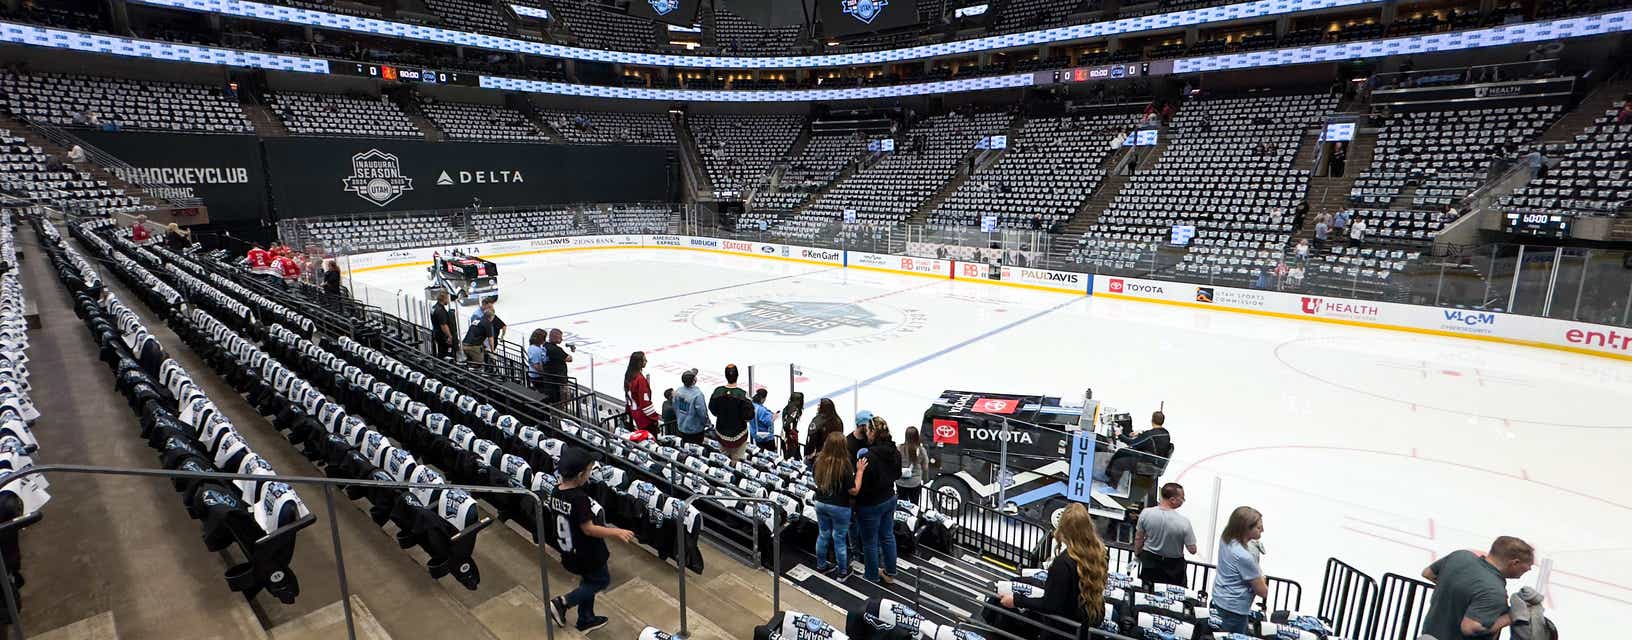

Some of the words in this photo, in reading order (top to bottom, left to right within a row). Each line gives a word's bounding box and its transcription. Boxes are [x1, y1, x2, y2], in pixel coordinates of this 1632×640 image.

[356, 161, 396, 170] INAUGURAL
[357, 169, 398, 179] SEASON
[459, 171, 524, 184] DELTA
[371, 185, 389, 194] UTAH
[722, 241, 753, 252] SEATGEEK
[808, 249, 822, 259] Ken
[1127, 283, 1164, 294] TOYOTA
[1325, 303, 1378, 316] HEALTH
[967, 430, 1032, 445] TOYOTA
[1074, 434, 1088, 497] UTAH
[557, 514, 573, 552] 9
[896, 613, 920, 627] GAME
